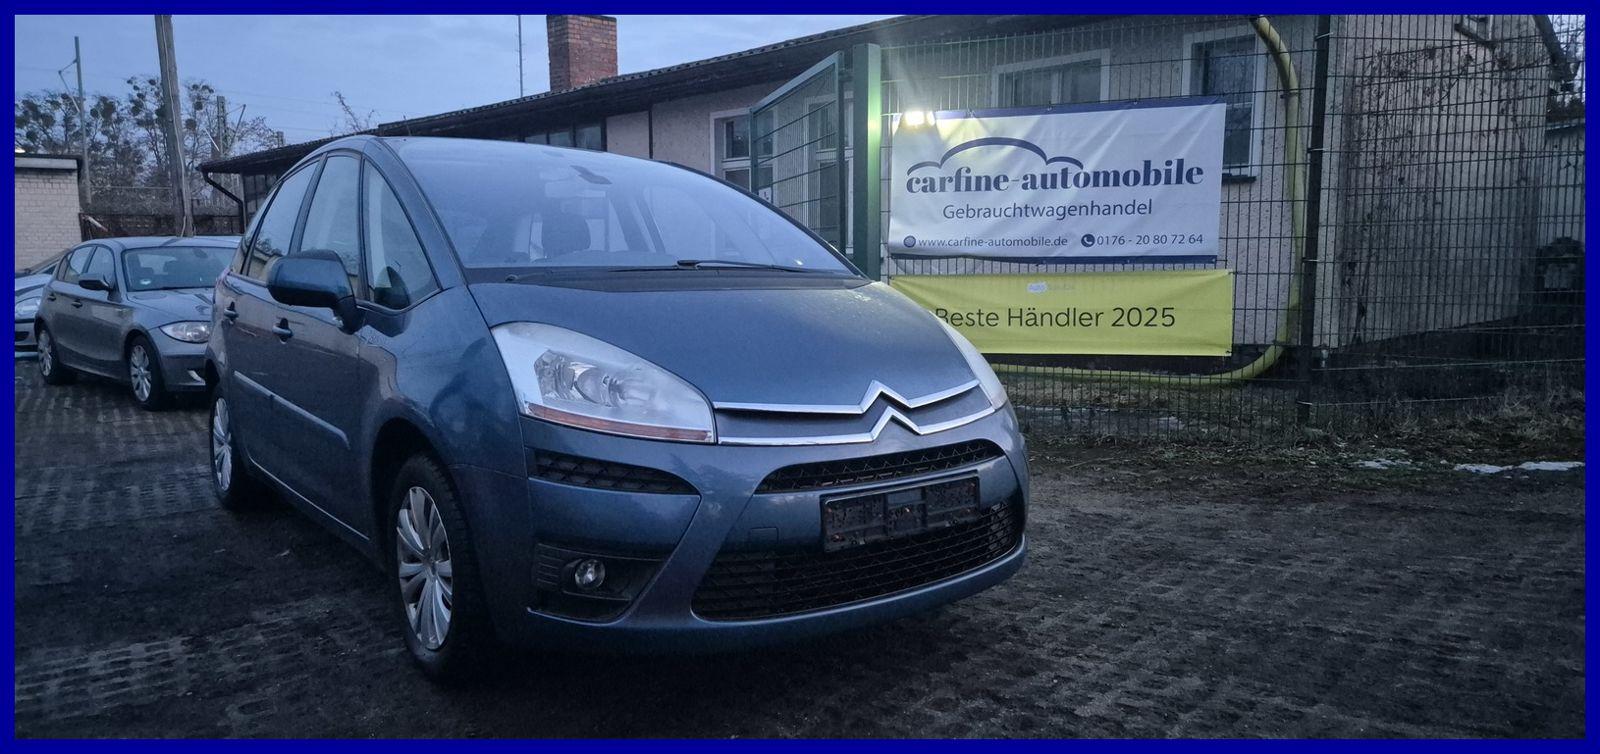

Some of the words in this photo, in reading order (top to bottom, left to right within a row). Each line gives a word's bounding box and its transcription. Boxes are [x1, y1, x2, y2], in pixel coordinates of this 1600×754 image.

[906, 158, 1204, 194] carfine-automobile
[942, 198, 1152, 221] Gebrauchtwagenhandel
[918, 236, 1068, 248] www.carfine-automobile.de
[1096, 235, 1125, 246] 0176
[1135, 234, 1150, 246] 20
[1152, 234, 1167, 245] 80
[1170, 234, 1186, 245] 72
[1189, 234, 1203, 245] 64
[1007, 307, 1104, 327] Händler
[1111, 307, 1176, 327] 2025
